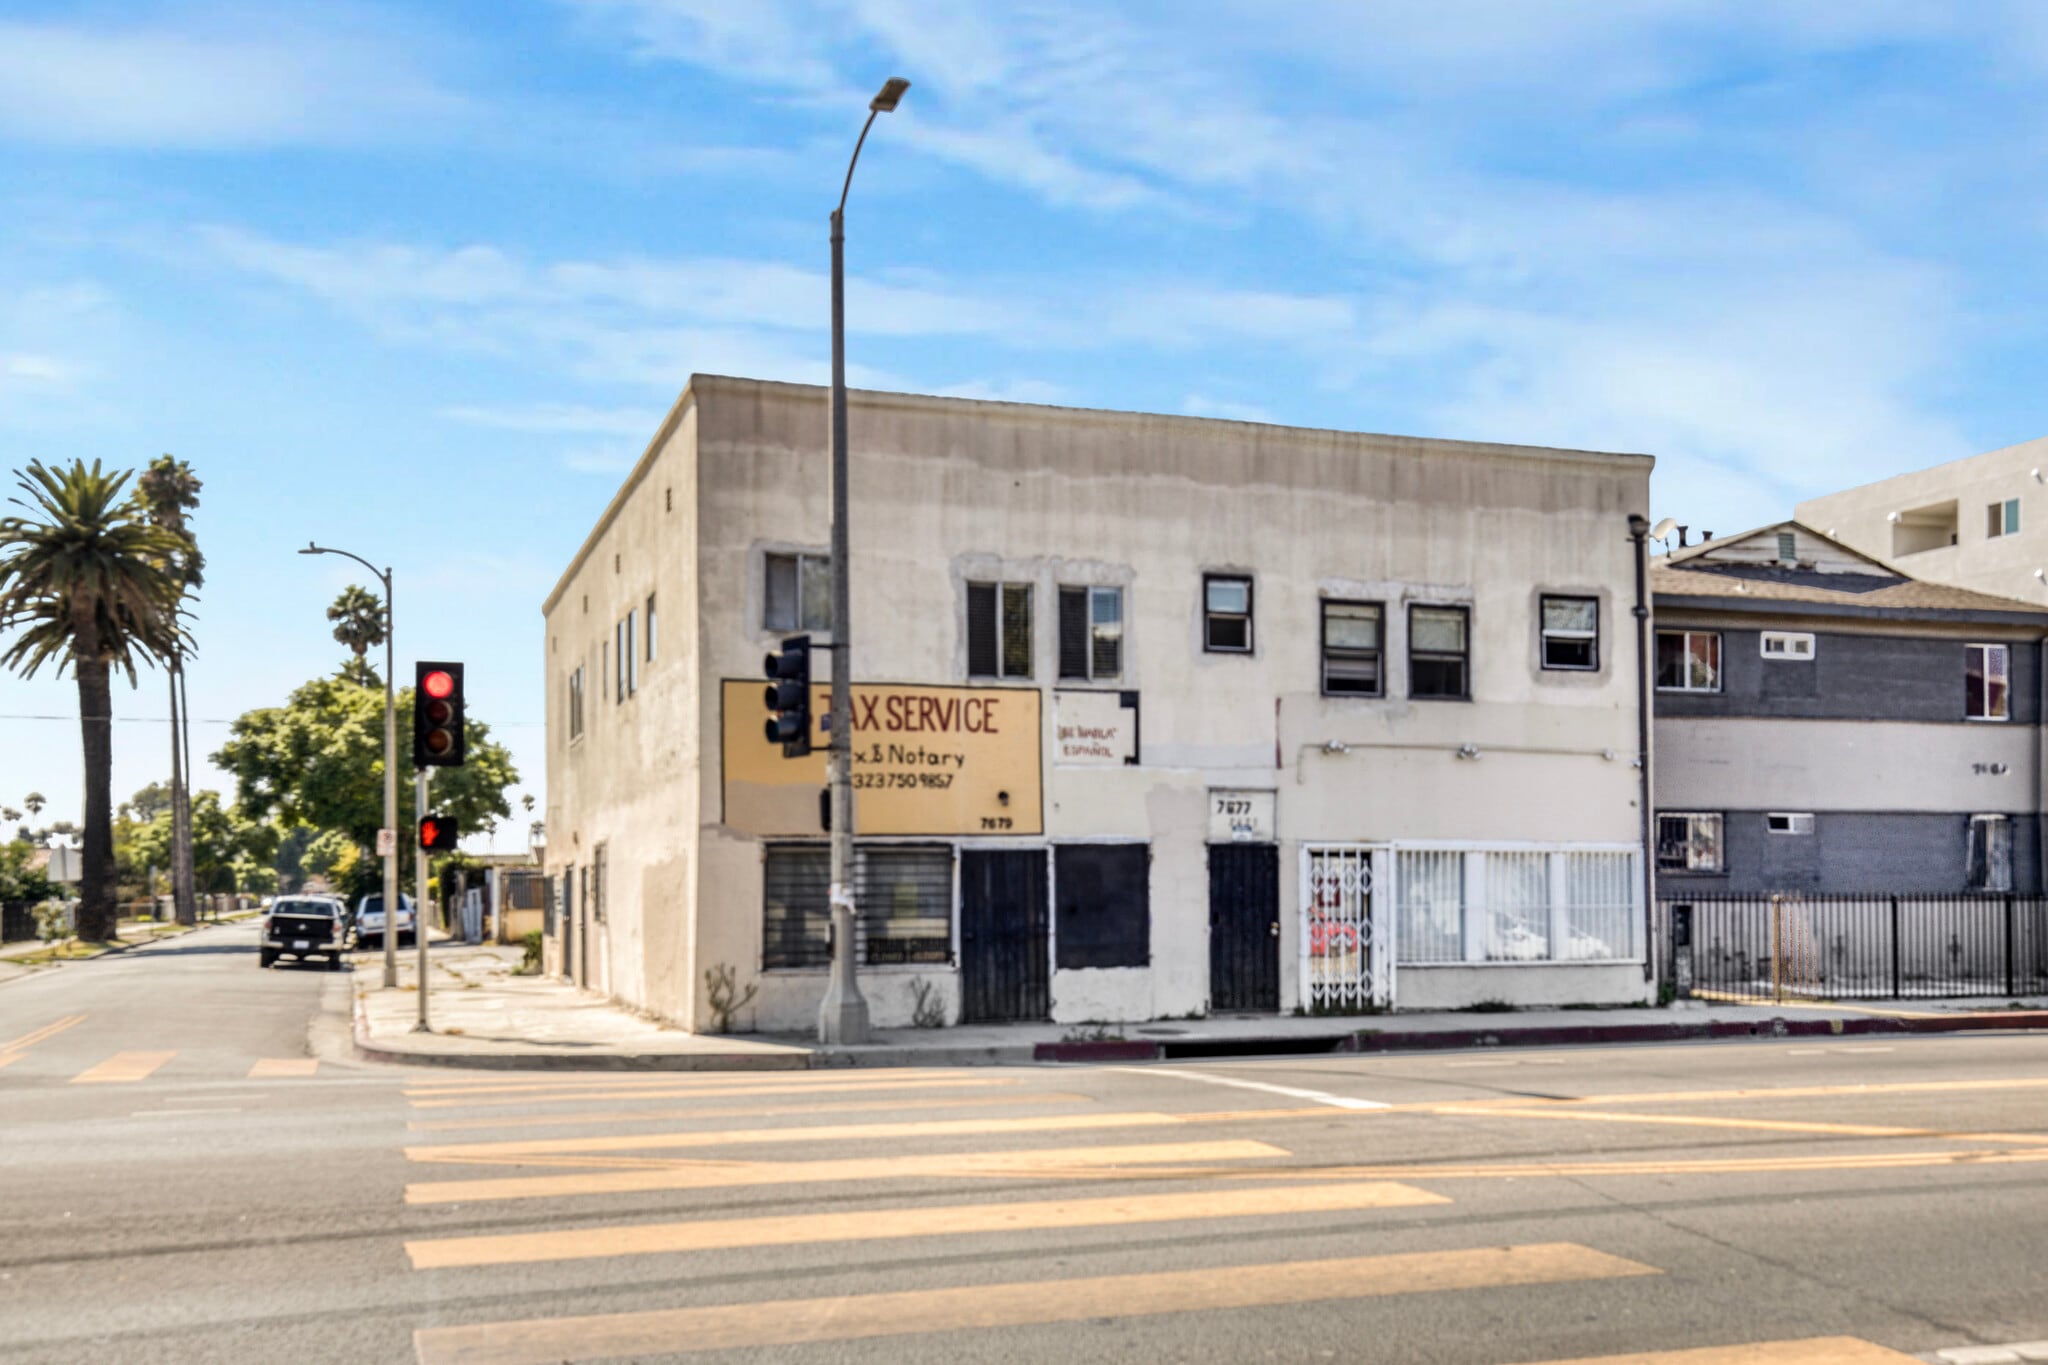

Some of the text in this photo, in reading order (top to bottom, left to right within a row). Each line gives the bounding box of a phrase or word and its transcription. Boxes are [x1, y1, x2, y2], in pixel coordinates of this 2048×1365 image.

[886, 694, 1001, 735] SERVICE
[889, 744, 966, 769] Notary
[1217, 799, 1252, 815] 7677
